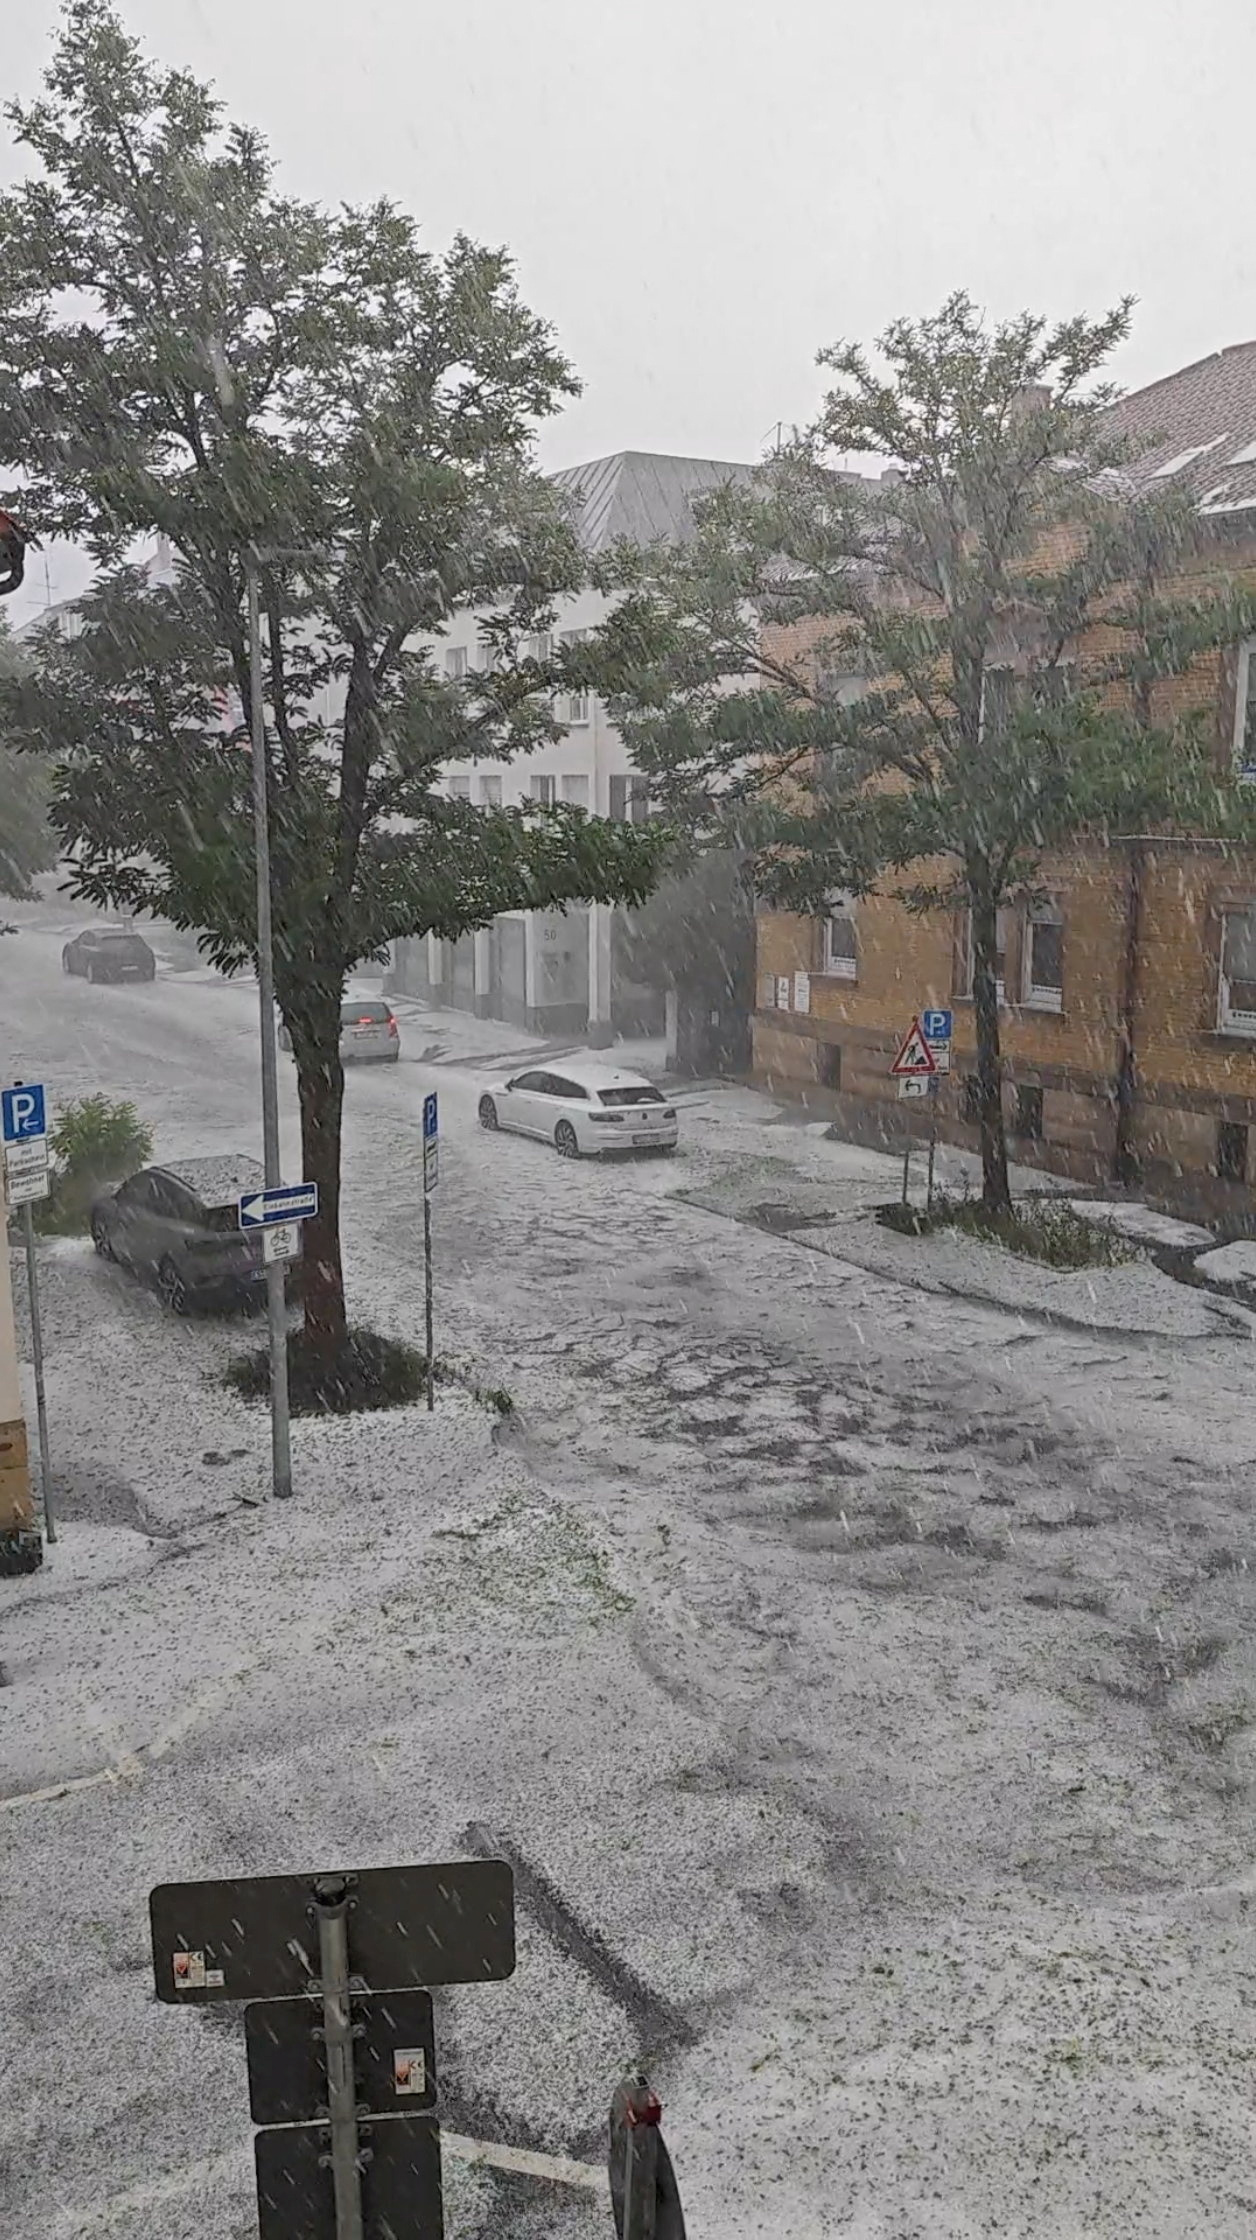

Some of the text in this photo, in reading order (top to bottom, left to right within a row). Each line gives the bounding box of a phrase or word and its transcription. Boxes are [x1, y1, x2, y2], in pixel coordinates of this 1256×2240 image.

[928, 1013, 946, 1036] P
[11, 1093, 35, 1134] P
[426, 1099, 435, 1134] P
[10, 1174, 45, 1190] Bewohner
